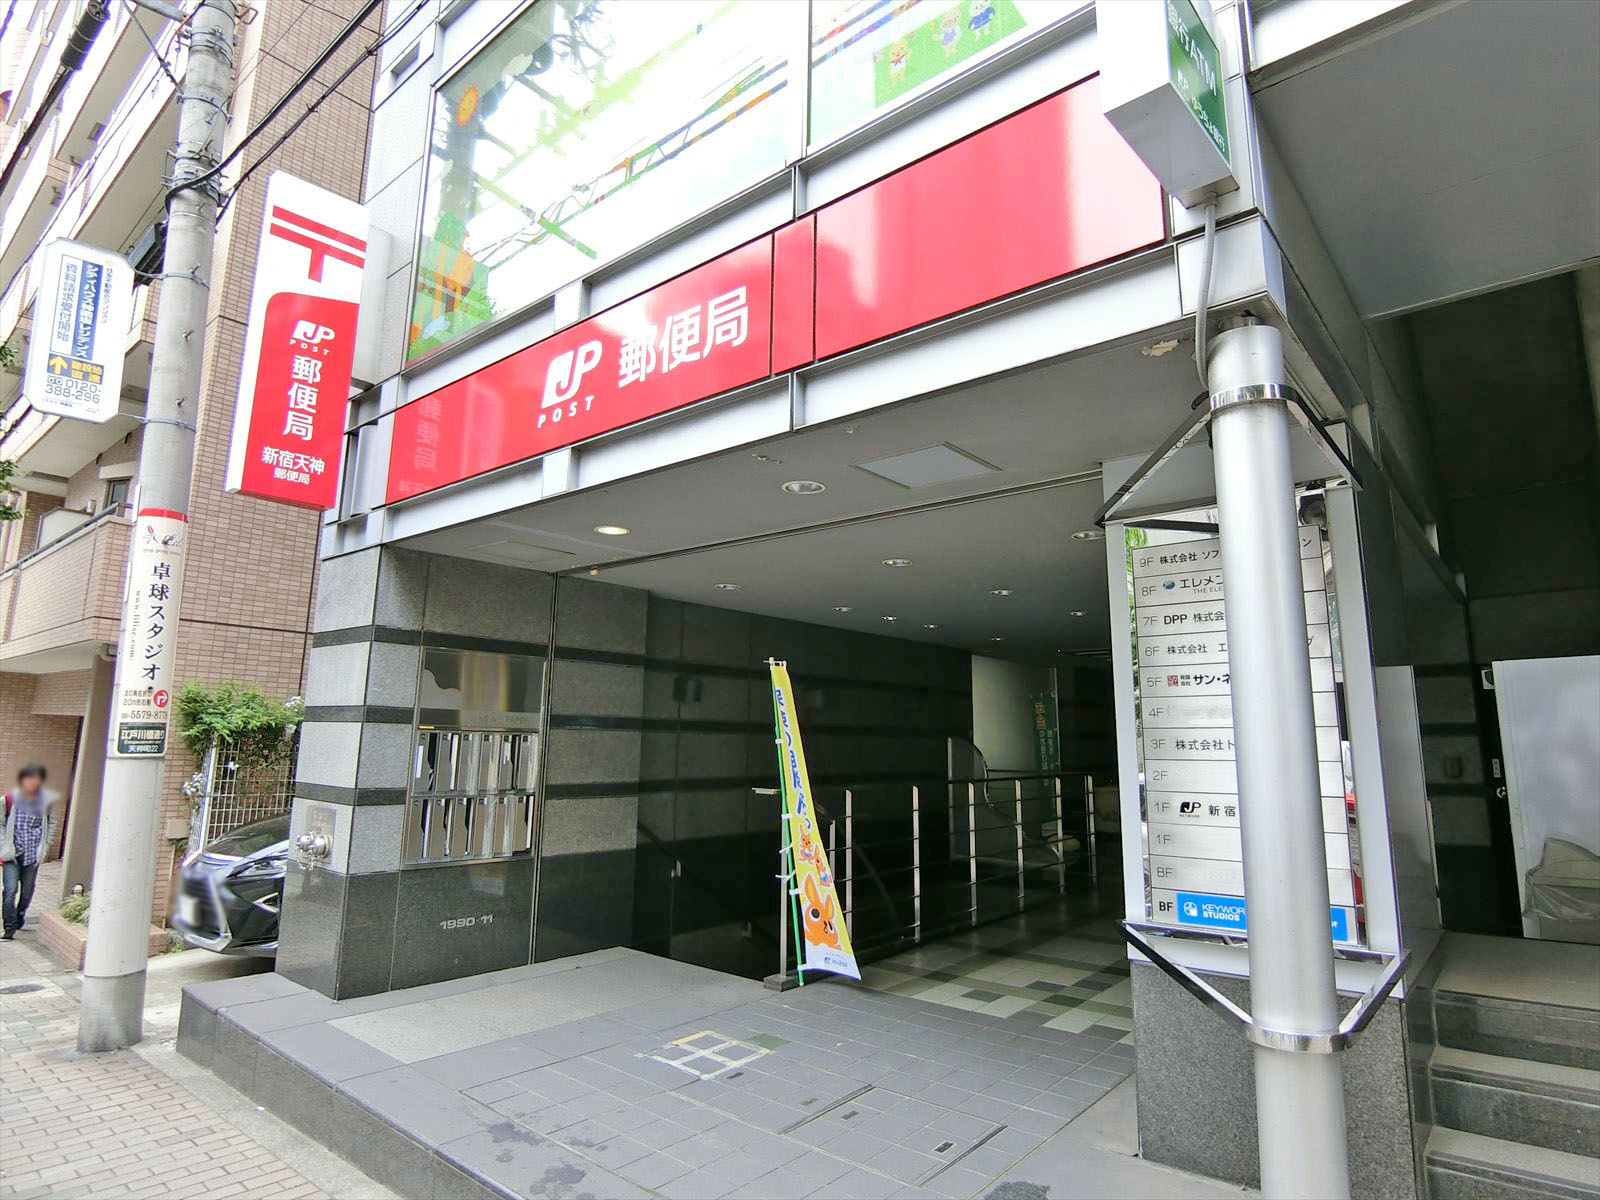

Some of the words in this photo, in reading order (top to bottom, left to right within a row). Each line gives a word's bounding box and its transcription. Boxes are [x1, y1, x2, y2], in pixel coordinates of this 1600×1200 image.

[618, 285, 748, 389] 郵便局
[290, 339, 329, 355] POST
[45, 384, 100, 404] 388-296
[283, 355, 322, 441] 郵便局
[537, 395, 595, 429] POST
[262, 446, 325, 475] 新宿天神
[273, 468, 310, 485] 郵便局
[1139, 557, 1154, 567] 9F
[1160, 552, 1198, 565] 株式会社
[1141, 586, 1157, 596] 8F
[141, 562, 171, 681] 卓球スタジオ
[1142, 616, 1158, 626] 7F
[1163, 614, 1188, 625] DPP
[1193, 611, 1225, 623] 株式会
[1144, 646, 1160, 657] 6F
[1167, 644, 1208, 655] 株式会社
[1146, 677, 1162, 688] 5F
[1148, 707, 1164, 718] 4F
[120, 730, 164, 740] 江戸川橋通り
[1150, 739, 1166, 750] 3F
[1152, 770, 1168, 781] 2F
[1154, 802, 1169, 813] 1F
[1156, 834, 1171, 845] 1F
[1156, 866, 1173, 878] BF
[1159, 901, 1173, 912] BF
[1203, 910, 1240, 922] STUDIOS
